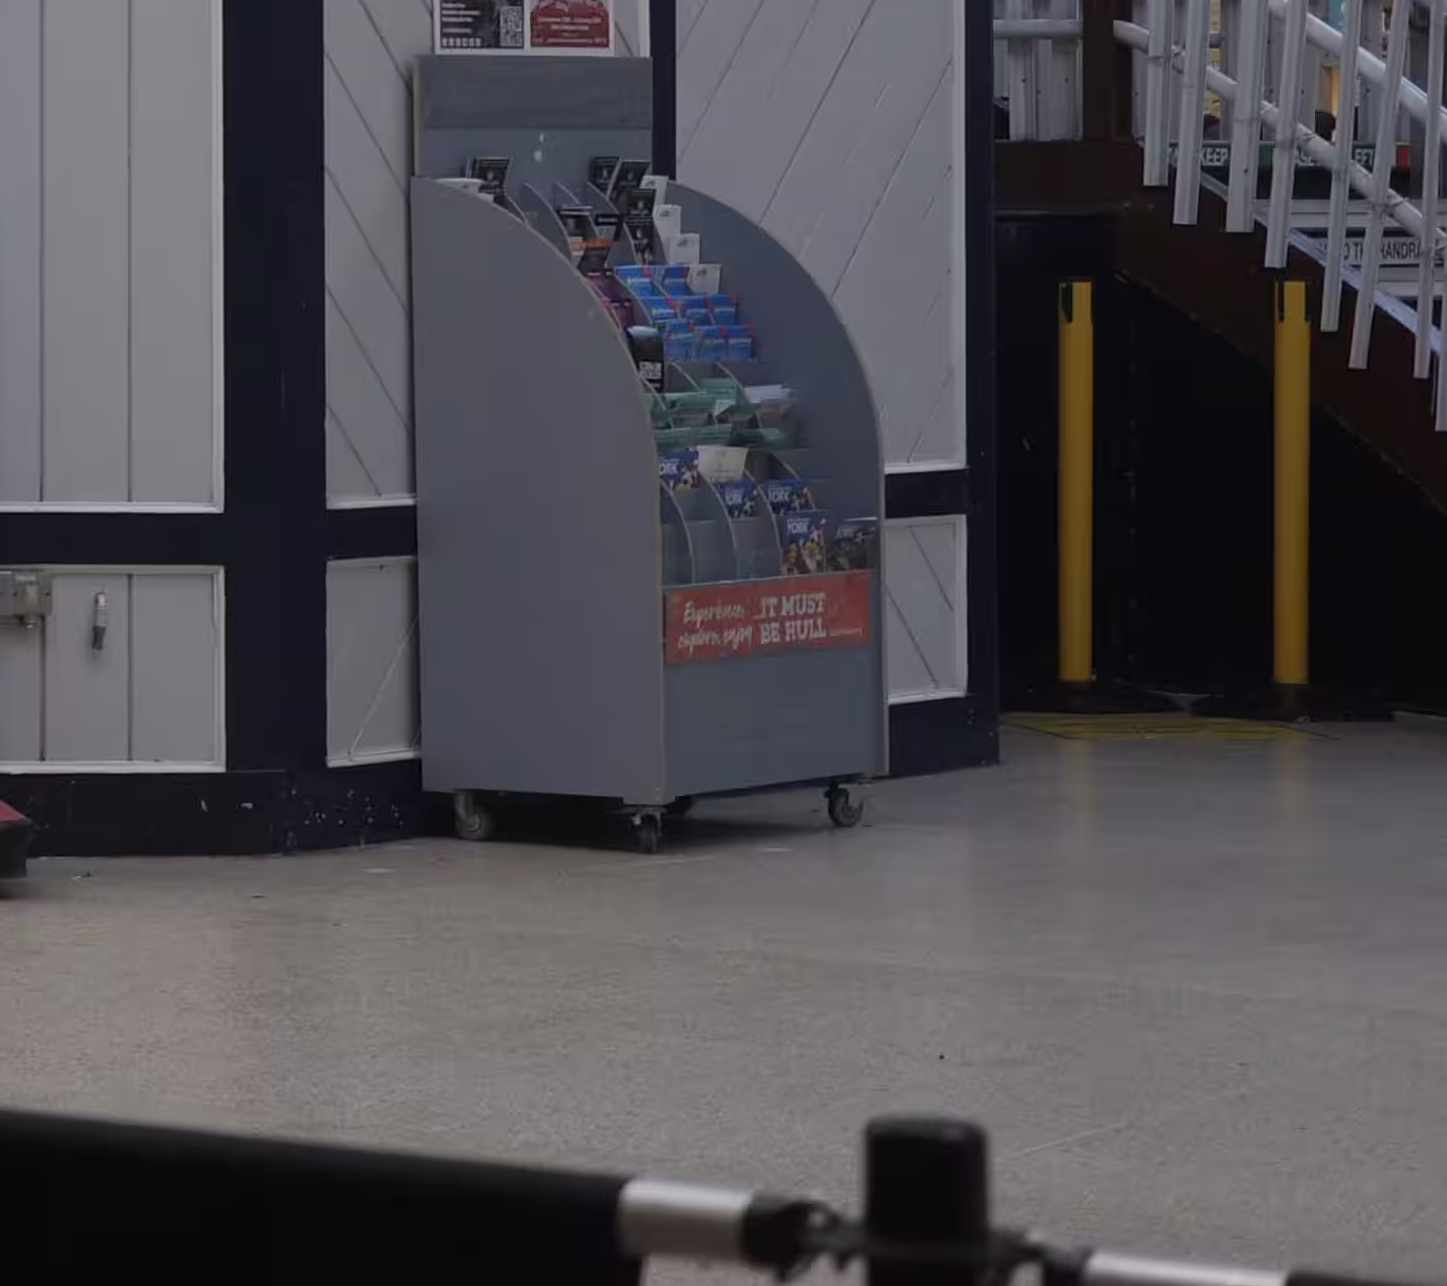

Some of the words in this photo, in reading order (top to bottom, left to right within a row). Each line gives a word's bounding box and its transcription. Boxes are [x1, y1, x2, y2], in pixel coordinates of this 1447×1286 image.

[781, 592, 827, 617] MUST
[760, 621, 780, 645] BE
[784, 618, 827, 643] HULL
